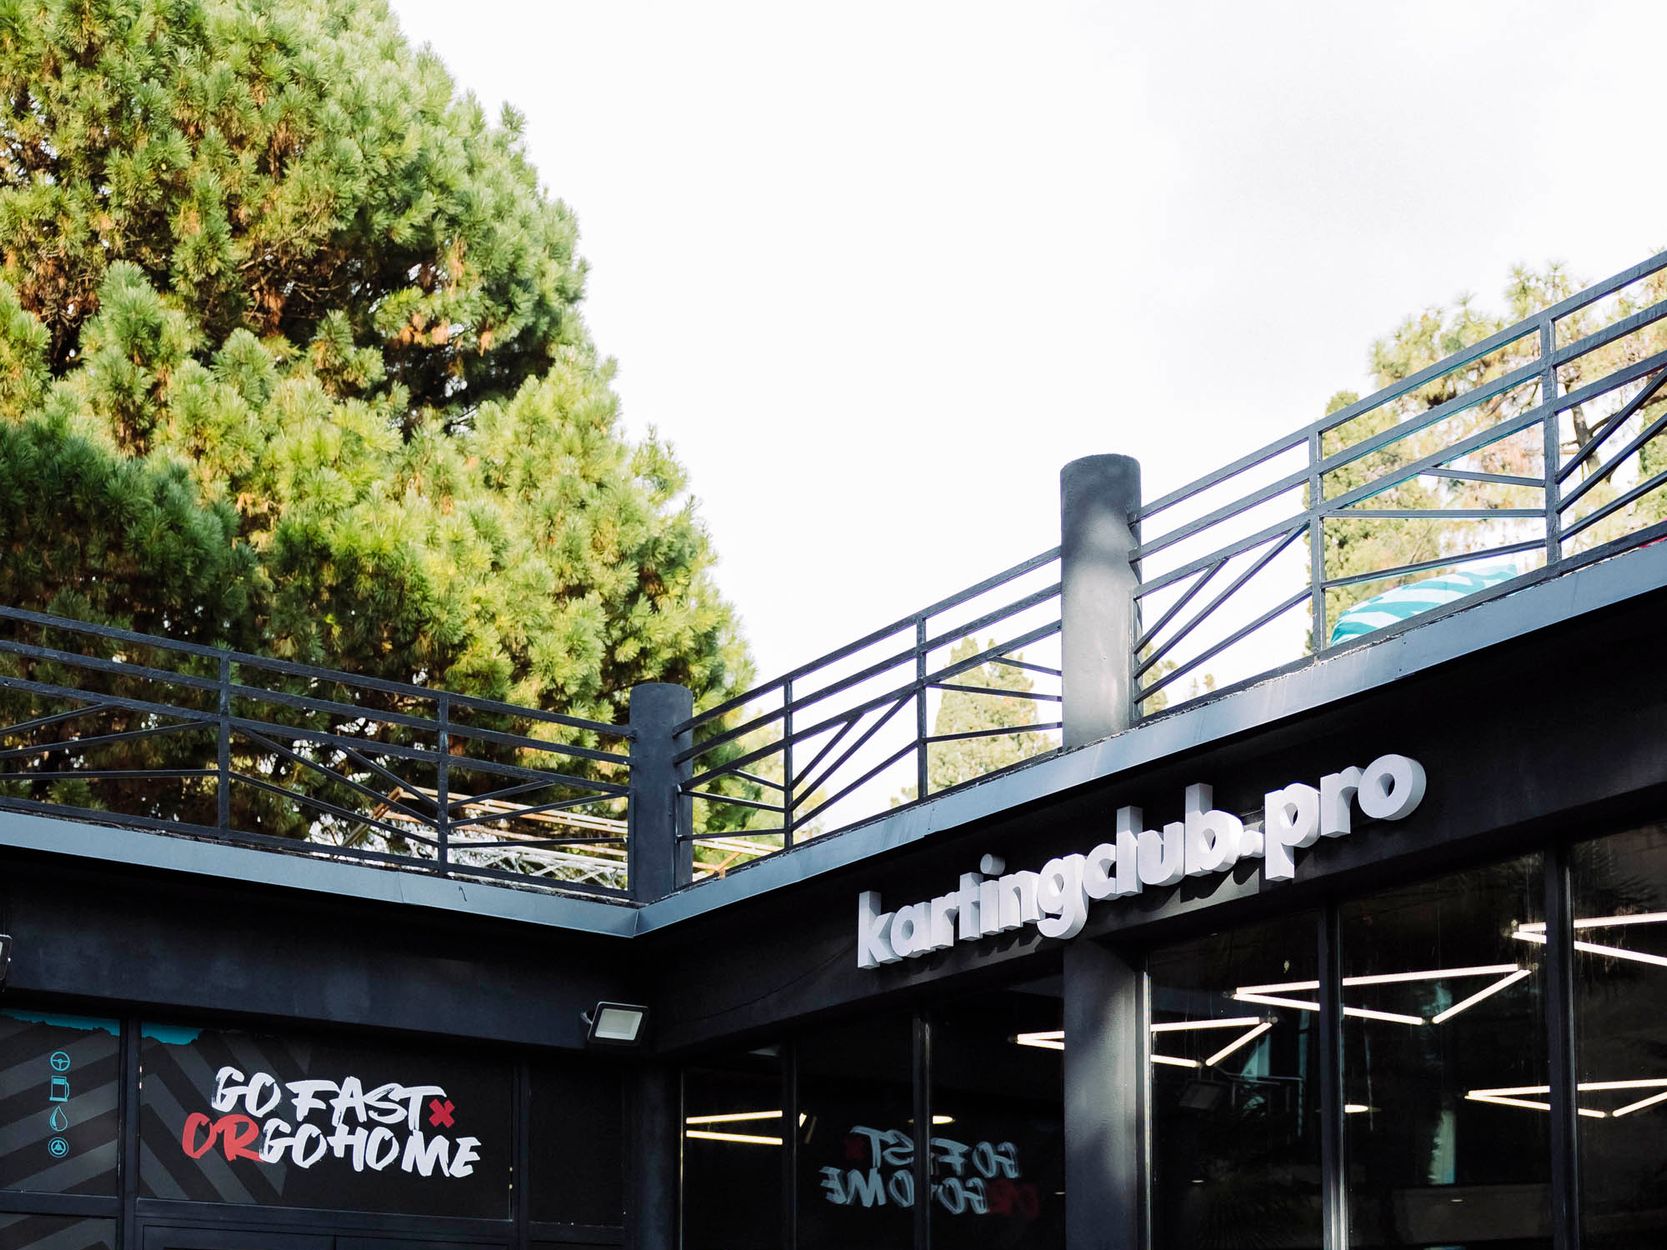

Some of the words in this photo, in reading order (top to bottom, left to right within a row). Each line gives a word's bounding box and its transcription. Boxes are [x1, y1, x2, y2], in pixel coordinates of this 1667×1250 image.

[857, 753, 1427, 969] kartingclub.pro
[211, 1066, 281, 1117] GO
[285, 1076, 447, 1131] FAST
[182, 1112, 264, 1163] OR
[258, 1118, 327, 1169] GO
[327, 1123, 482, 1178] HOME
